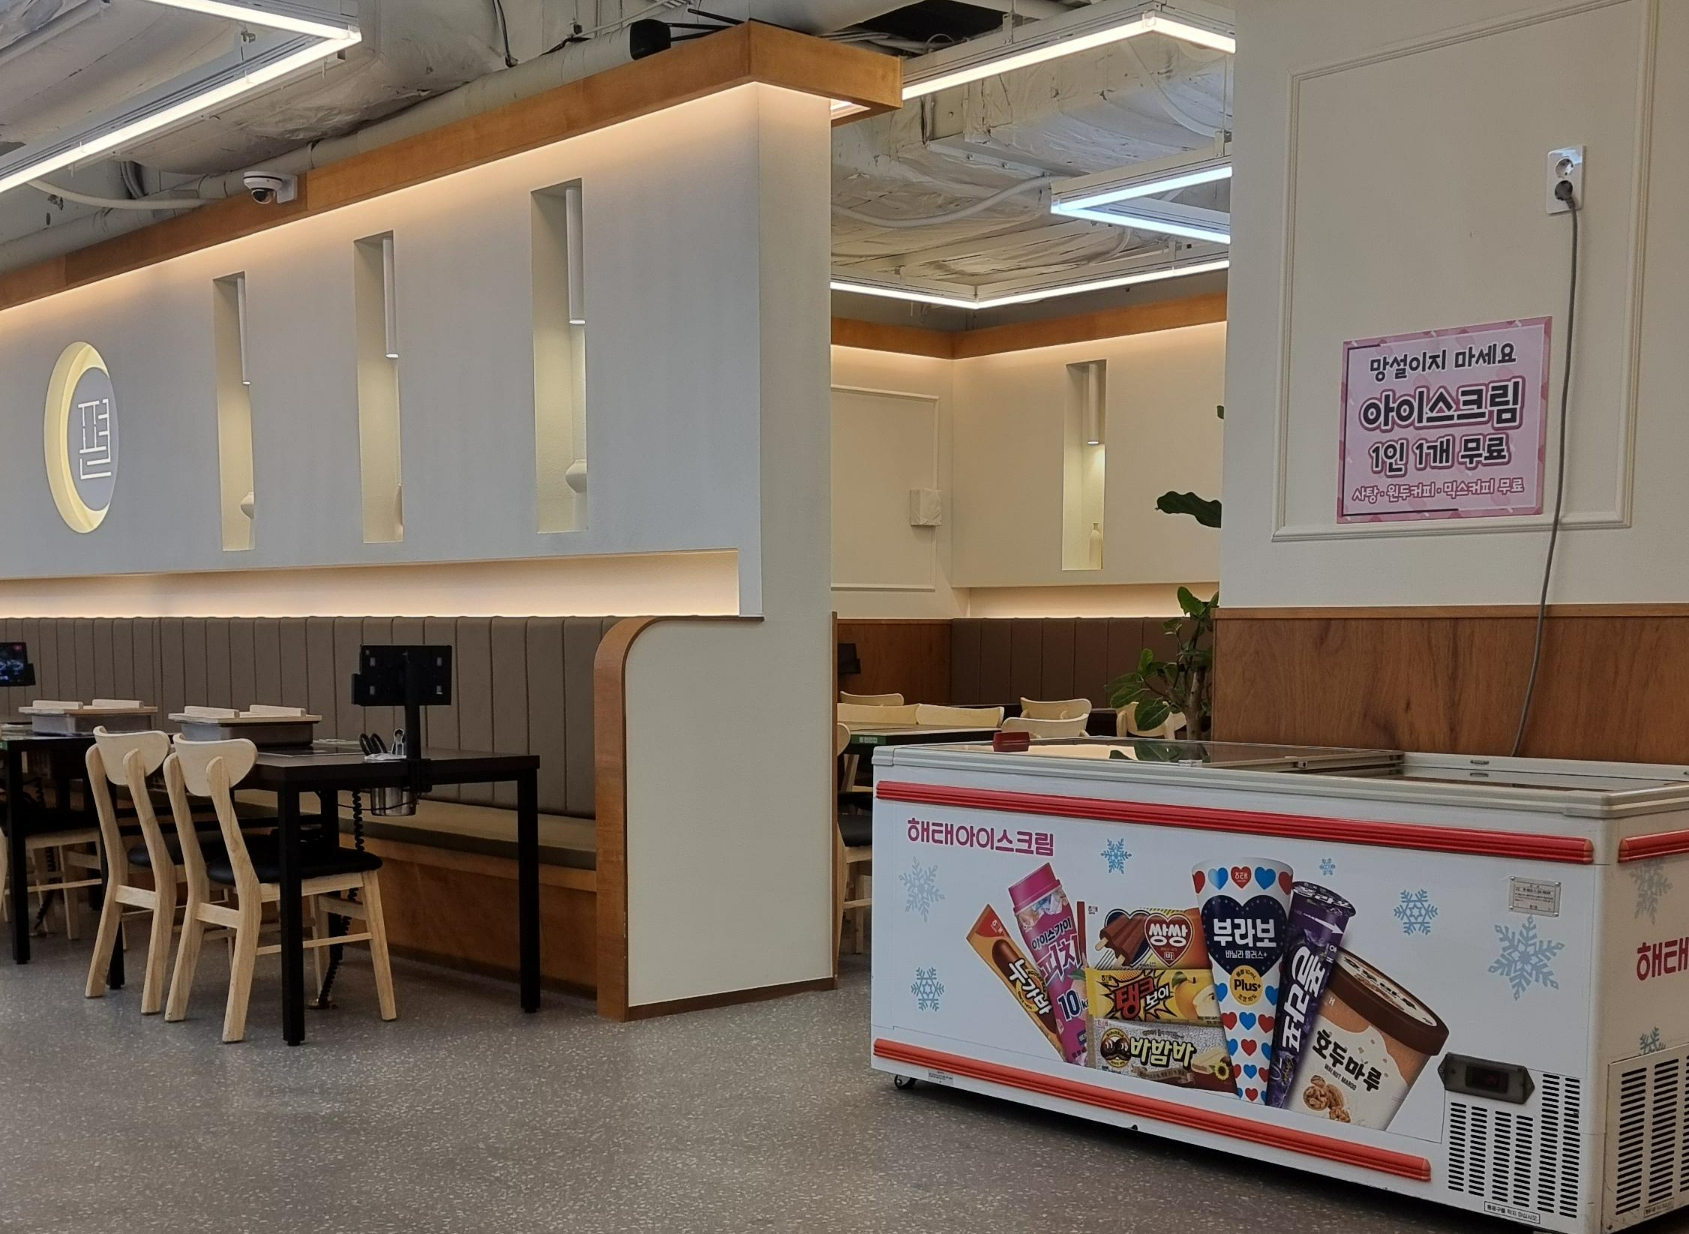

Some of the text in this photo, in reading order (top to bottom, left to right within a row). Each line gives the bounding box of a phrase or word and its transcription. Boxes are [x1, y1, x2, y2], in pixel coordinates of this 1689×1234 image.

[1370, 342, 1516, 382] 망설이지 마세요
[1361, 378, 1523, 430] 아이스크림
[1370, 435, 1508, 474] 1인 1개 무료
[1498, 477, 1525, 494] 무료
[907, 817, 1054, 857] 해태아이스크림
[1031, 917, 1072, 951] 아이스가이
[1148, 922, 1188, 947] 쌍쌍
[1213, 918, 1277, 948] 부라보
[1037, 933, 1082, 986] 피치
[1225, 950, 1243, 959] 바닐라
[1008, 958, 1053, 1015] 누가바
[1056, 989, 1081, 1022] 10
[1114, 976, 1155, 1020] 탱크
[1145, 983, 1171, 1011] 보이
[1282, 946, 1326, 1053] 폴라포
[1130, 1036, 1197, 1068] 바밤바
[1312, 1029, 1382, 1092] 호두마루
